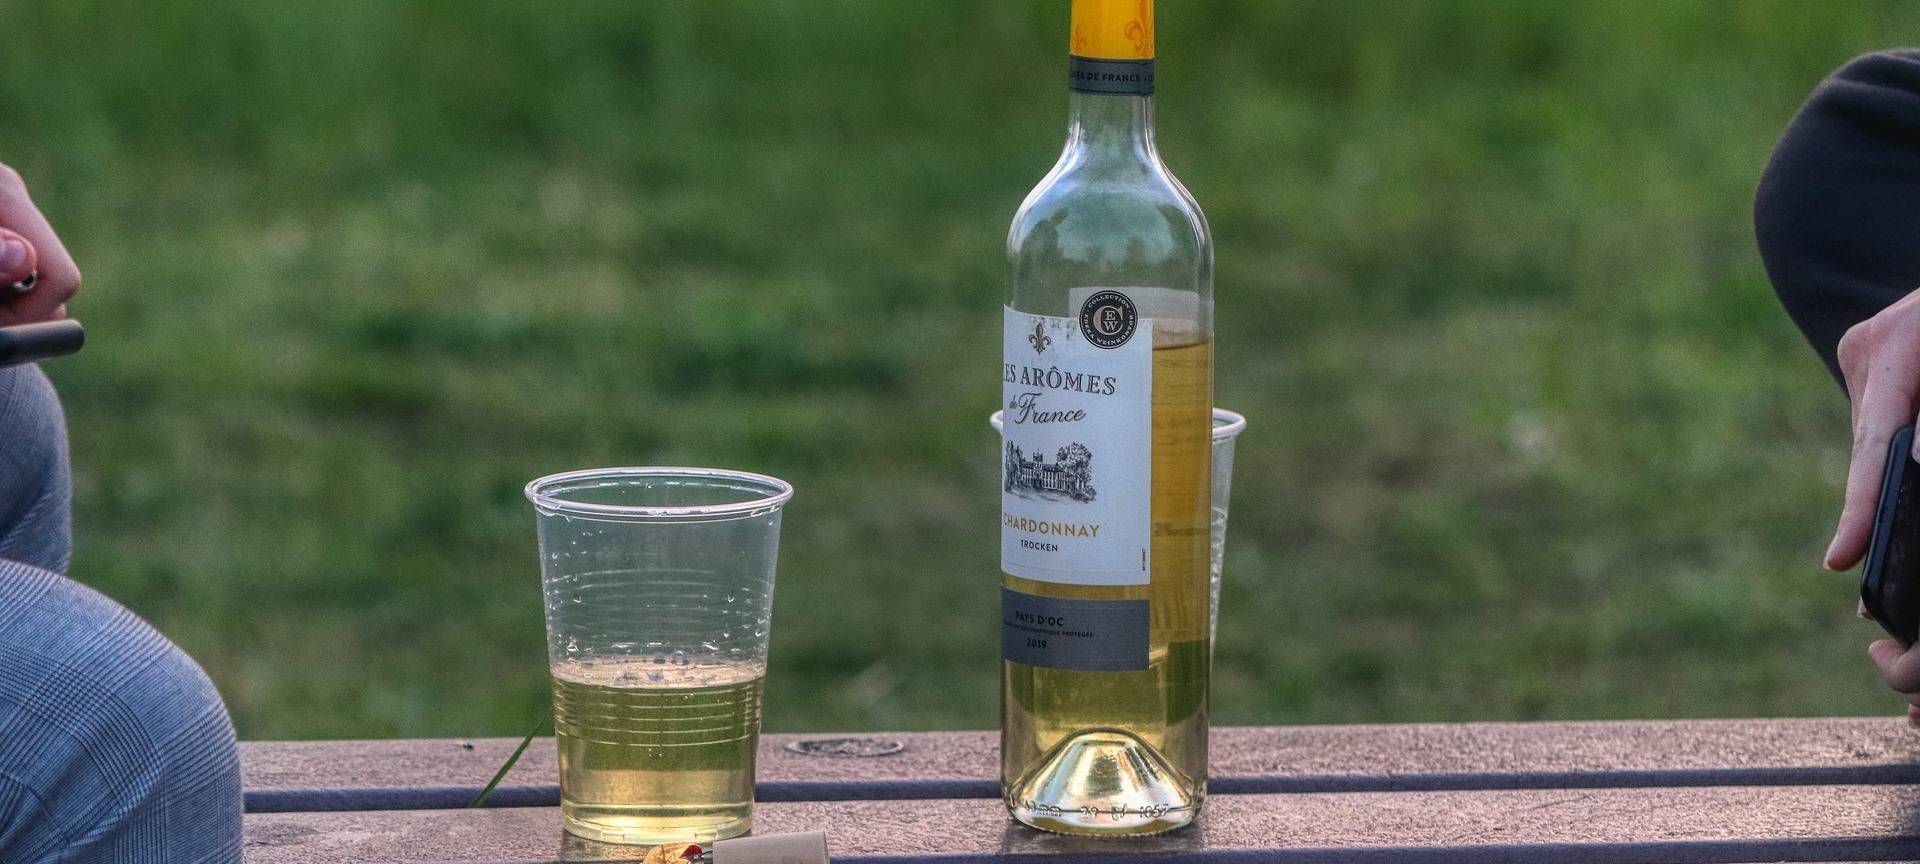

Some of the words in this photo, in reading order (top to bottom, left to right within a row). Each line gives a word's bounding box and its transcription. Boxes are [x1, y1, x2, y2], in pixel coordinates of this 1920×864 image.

[1087, 72, 1099, 80] DE
[1102, 73, 1140, 82] FRANCE
[1088, 294, 1131, 309] COLLECTION
[1003, 363, 1016, 383] ES
[1020, 365, 1117, 396] ARÔMES
[1014, 392, 1087, 425] France
[1003, 512, 1100, 537] CHARDONNAY
[1020, 539, 1058, 552] TROCKEN
[1015, 610, 1035, 624] PAYS
[1037, 615, 1065, 627] D'OC
[1026, 637, 1047, 649] 2019
